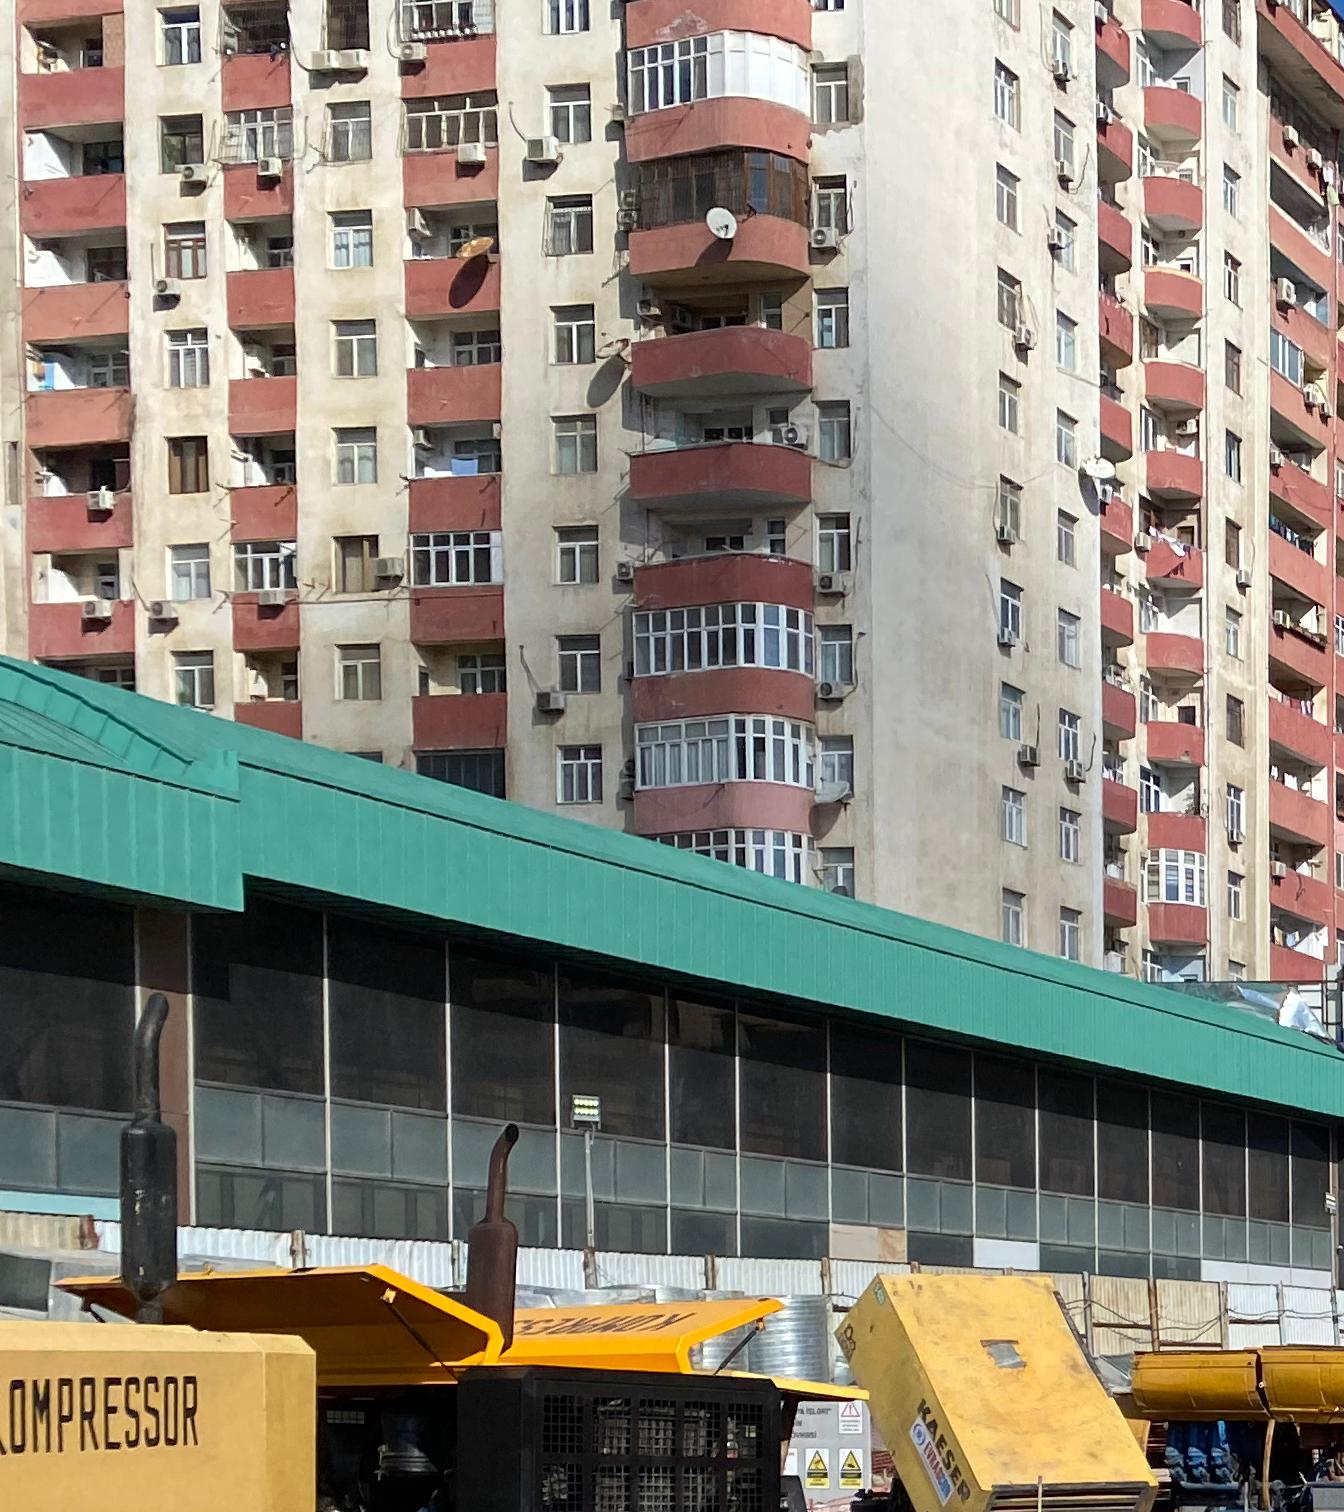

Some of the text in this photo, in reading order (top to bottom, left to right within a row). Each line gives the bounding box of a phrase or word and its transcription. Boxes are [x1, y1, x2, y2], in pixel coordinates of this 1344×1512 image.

[0, 1375, 199, 1455] OMPRESSOR
[917, 1397, 971, 1504] KAESER
[923, 1439, 951, 1499] EVRASCON
